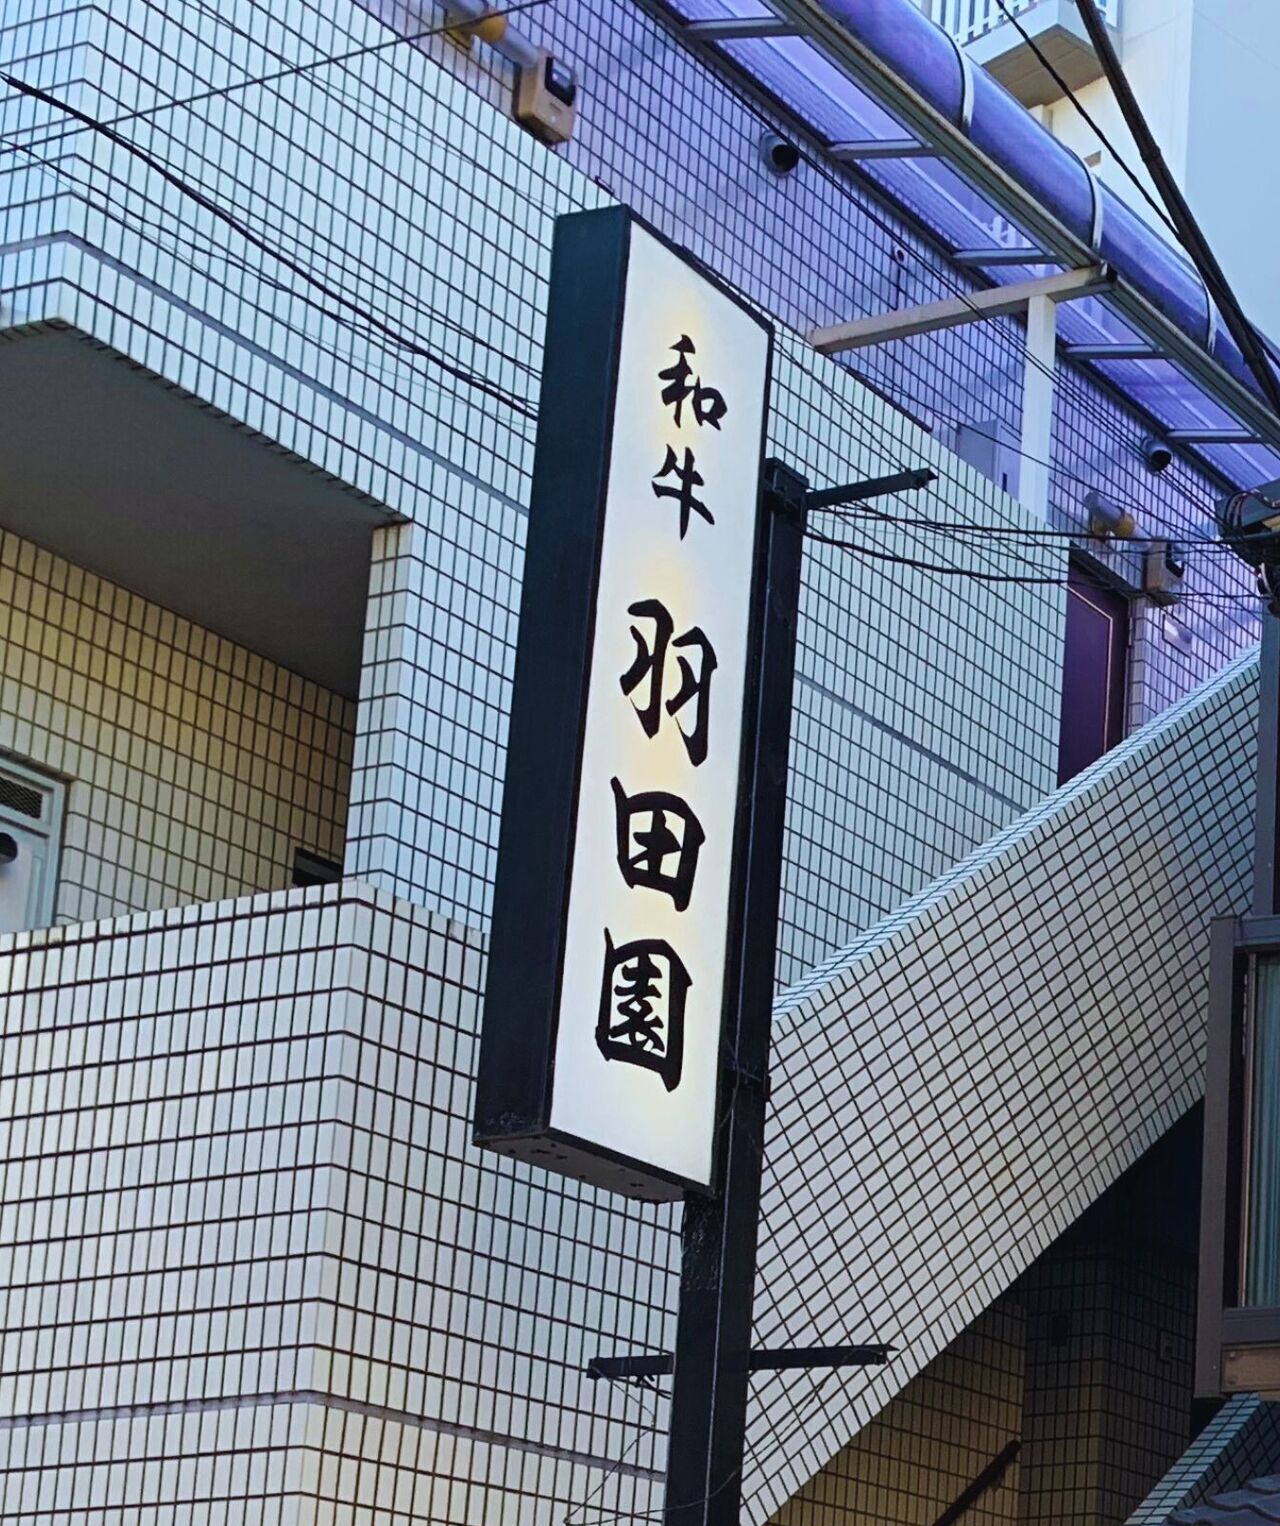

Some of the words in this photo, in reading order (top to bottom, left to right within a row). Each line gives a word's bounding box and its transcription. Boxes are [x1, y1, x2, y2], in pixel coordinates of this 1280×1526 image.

[653, 334, 728, 540] 和牛
[596, 598, 721, 1091] 羽田園
